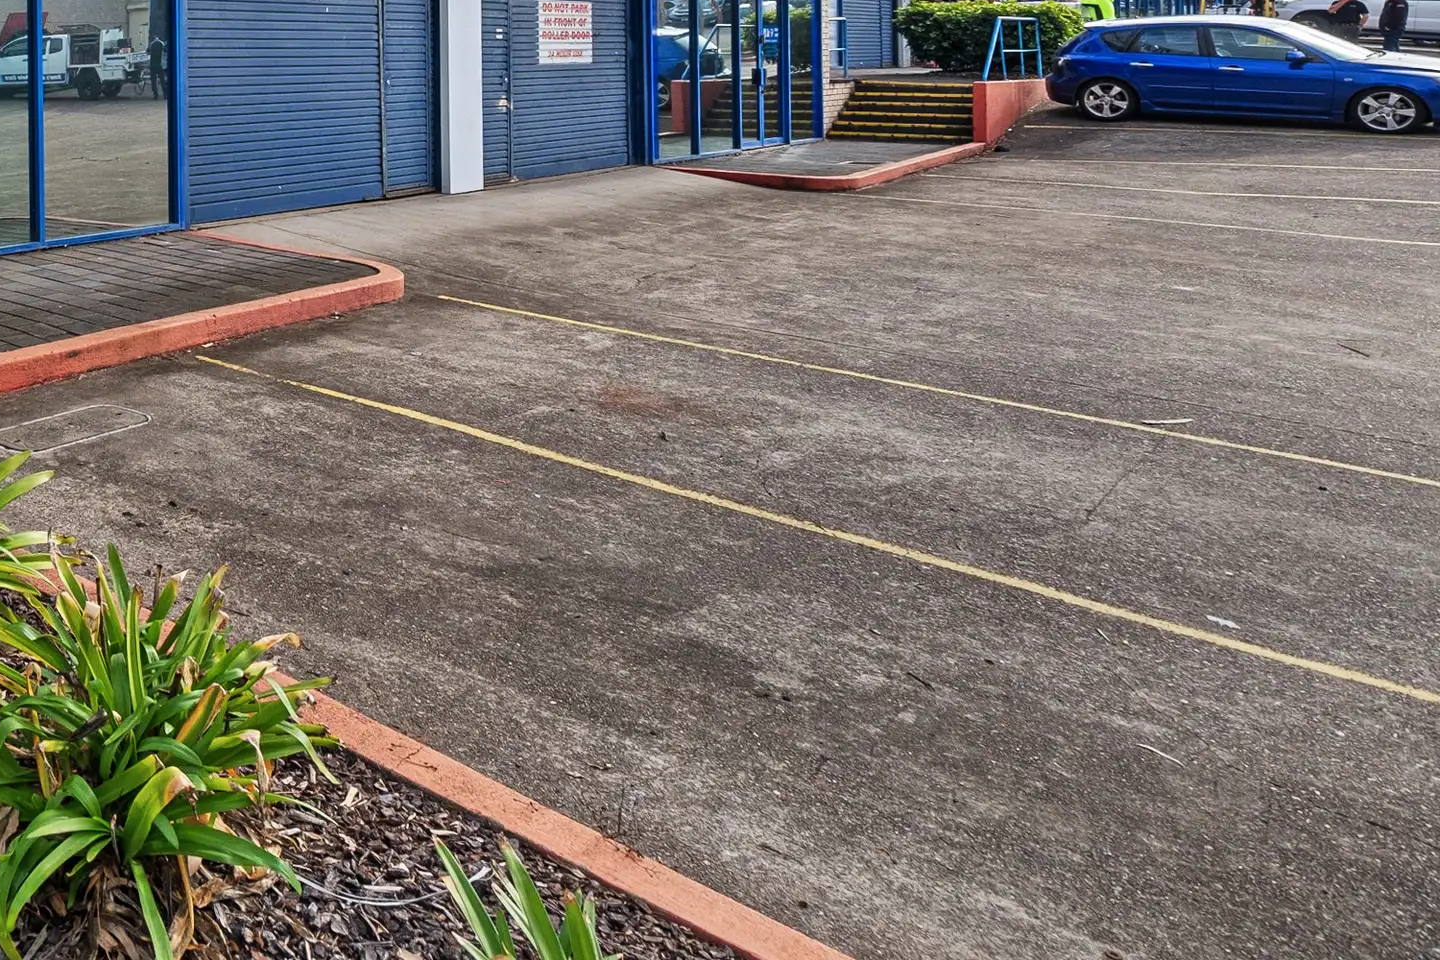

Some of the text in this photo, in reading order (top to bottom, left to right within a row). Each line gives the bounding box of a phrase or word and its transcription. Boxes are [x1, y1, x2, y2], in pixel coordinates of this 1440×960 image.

[542, 3, 589, 13] DO NOT PARK
[544, 17, 587, 27] IN FRONT OF
[542, 30, 591, 40] ROLLER DOOR
